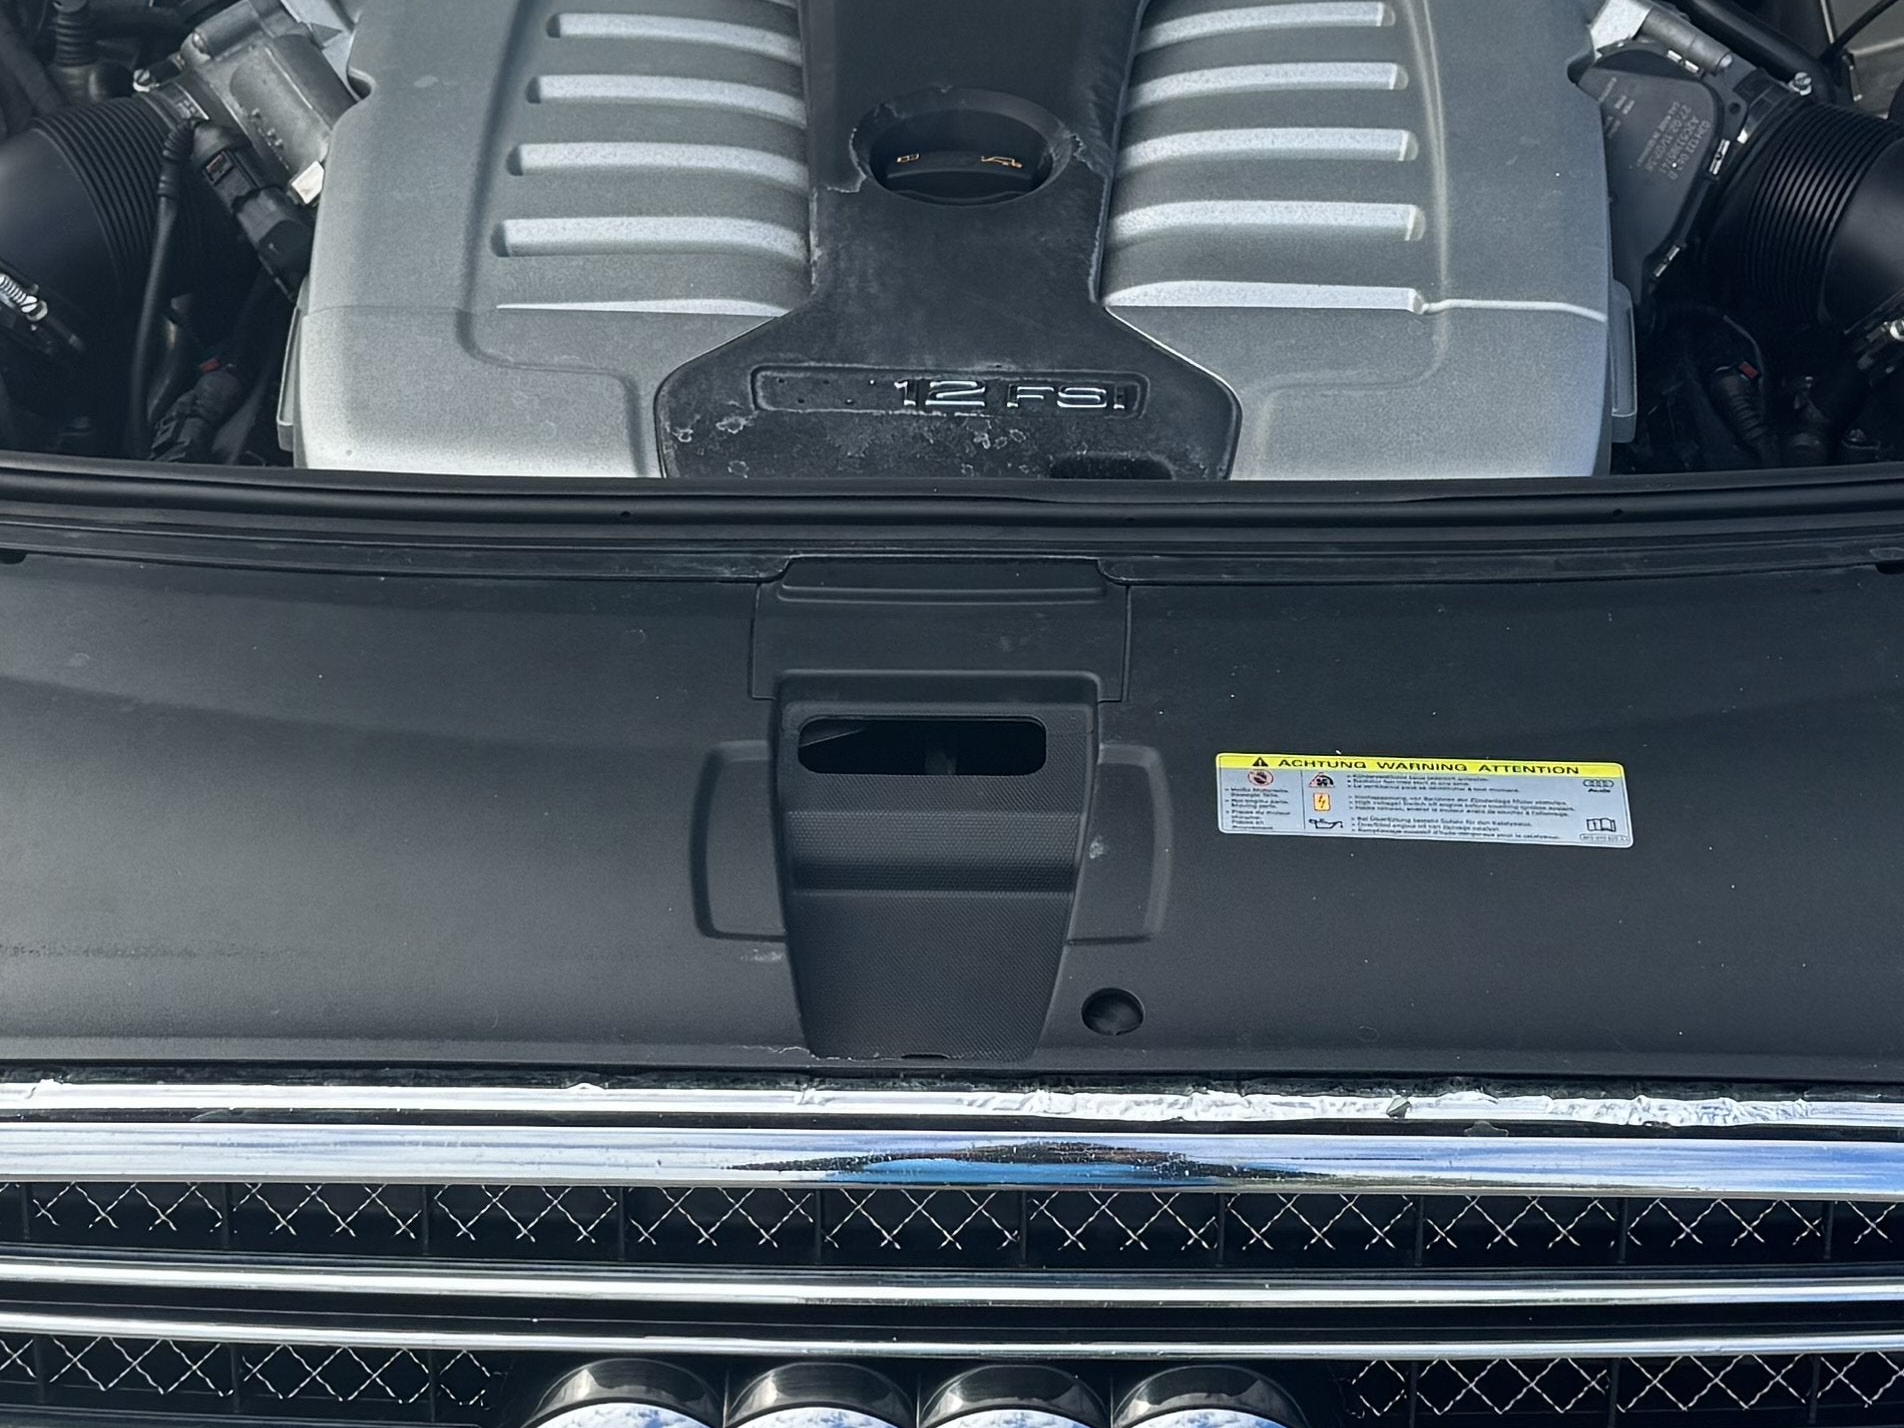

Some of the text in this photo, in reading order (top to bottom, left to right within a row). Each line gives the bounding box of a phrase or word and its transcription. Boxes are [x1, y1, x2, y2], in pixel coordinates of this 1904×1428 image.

[1005, 381, 1126, 410] FSI
[1277, 759, 1580, 775] ACHTUNG WARNING ATTENTION
